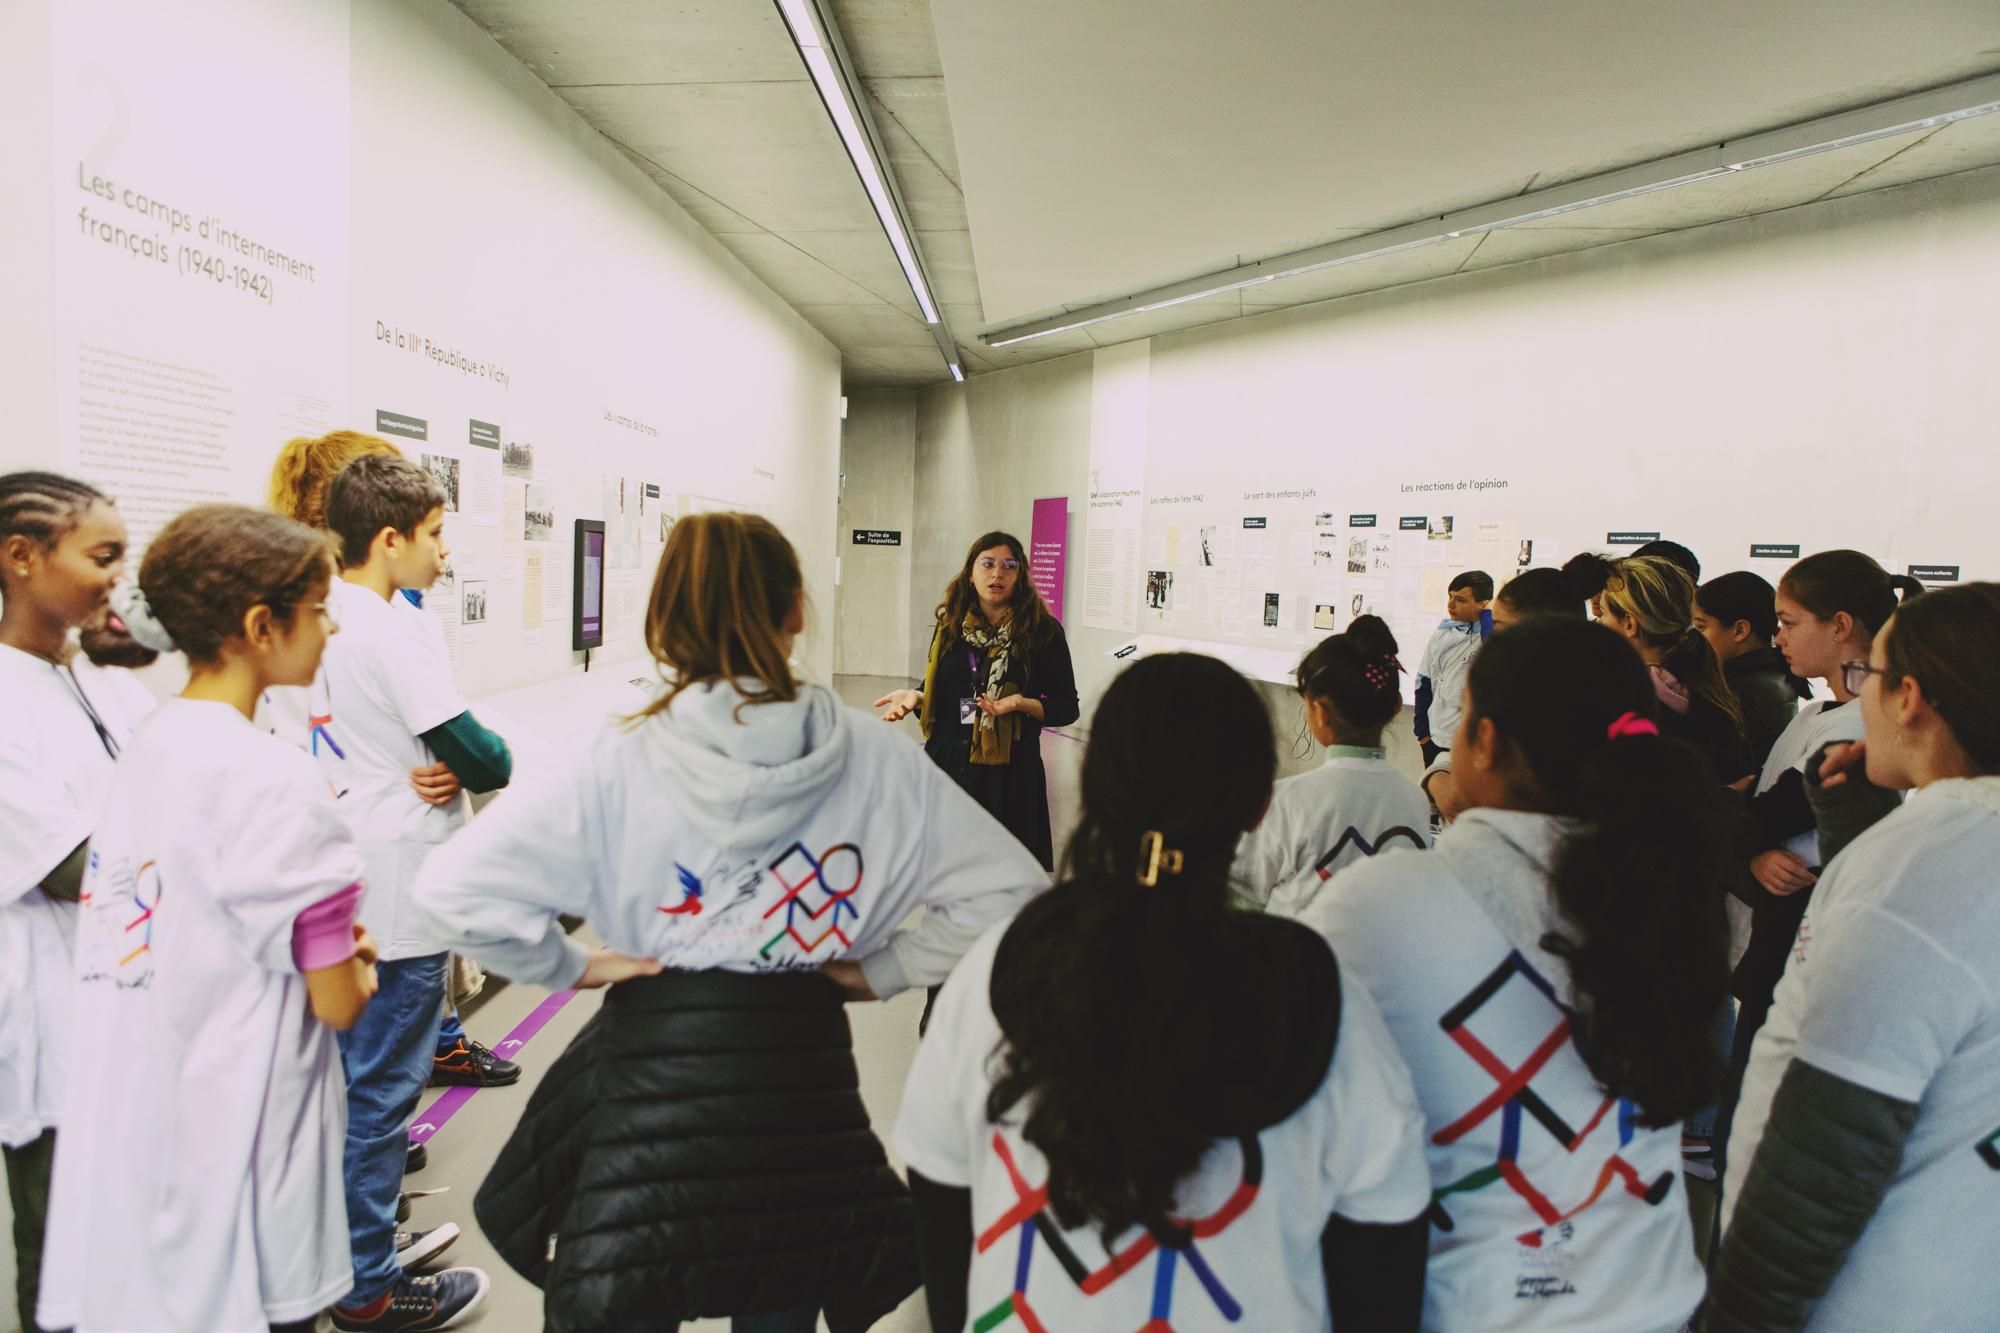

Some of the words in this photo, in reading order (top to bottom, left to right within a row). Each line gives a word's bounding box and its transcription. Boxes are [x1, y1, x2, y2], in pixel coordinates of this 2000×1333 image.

[78, 161, 116, 201] Les
[122, 187, 192, 233] camps
[199, 215, 315, 283] d'internement
[78, 206, 170, 264] français
[177, 243, 274, 306] (1940-1942)
[376, 320, 391, 344] De
[395, 327, 405, 349] la
[425, 338, 478, 377] République
[488, 362, 511, 391] Vichy
[1243, 491, 1251, 500] Le
[1251, 491, 1264, 499] sort
[1265, 491, 1275, 499] des
[1276, 489, 1301, 499] enfants
[1301, 488, 1317, 500] juifs
[1400, 483, 1414, 493] Les
[1415, 480, 1455, 492] réactions
[1456, 480, 1468, 490] de
[1469, 478, 1508, 492] l'opinion
